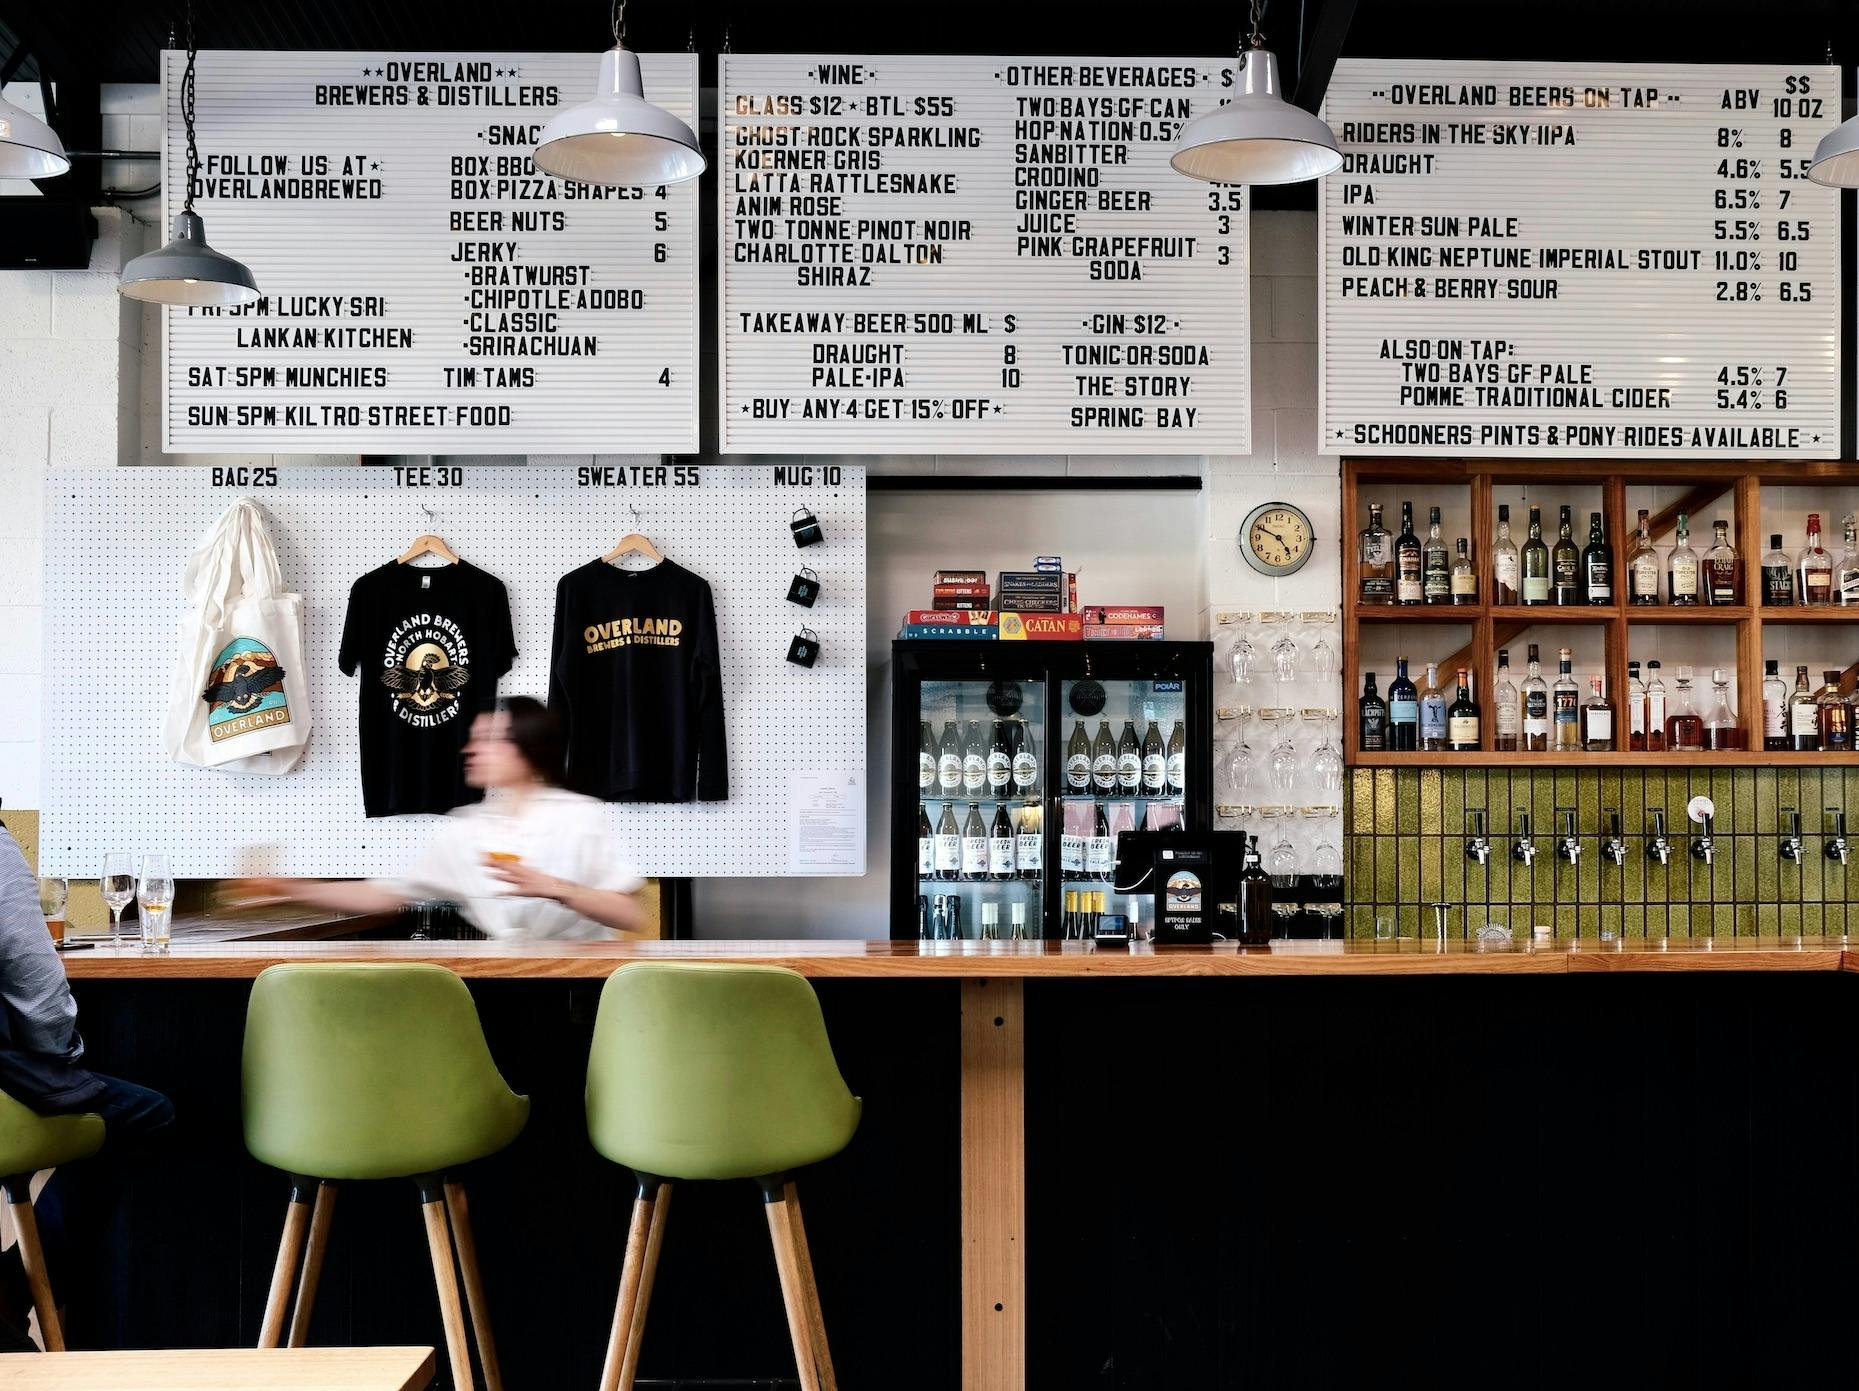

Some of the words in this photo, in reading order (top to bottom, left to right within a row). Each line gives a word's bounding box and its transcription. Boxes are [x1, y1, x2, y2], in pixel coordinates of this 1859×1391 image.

[387, 62, 491, 82] OVERLAND
[819, 65, 863, 84] WINE
[1008, 66, 1072, 86] OTHER
[1080, 67, 1195, 87] BEVERAGES
[316, 85, 407, 105] BREWERS
[417, 86, 429, 105] &
[438, 86, 557, 106] DISTILLERS
[736, 95, 802, 116] GLASS
[810, 96, 841, 115] $12
[867, 96, 904, 116] BTL
[915, 97, 952, 116] $55
[1392, 85, 1496, 105] OVERLAND
[1510, 87, 1573, 106] BEERS
[1584, 88, 1609, 108] ON
[1621, 88, 1657, 107] TAP
[1722, 89, 1759, 109] ABV
[1774, 99, 1791, 117] 10
[1799, 99, 1822, 118] OZ
[737, 127, 800, 146] GHOST
[808, 127, 860, 146] ROCK
[869, 127, 980, 147] SPARKLING
[1344, 123, 1414, 143] RIDERS
[1422, 124, 1440, 144] IN
[1448, 124, 1485, 144] THE
[1493, 125, 1529, 144] SKY
[1538, 126, 1575, 145] IIPA
[1718, 128, 1742, 147] 8%
[1780, 129, 1791, 148] 8
[1016, 144, 1126, 164] SANBITTER
[208, 155, 287, 175] FOLLOW
[302, 156, 327, 175] US
[343, 156, 366, 175] AT
[736, 173, 800, 192] LATTA
[811, 174, 955, 193] RATTLESNAKE
[1015, 167, 1098, 187] CRODINO
[193, 179, 382, 199] OVERLANDBREWED
[451, 212, 502, 231] BEER
[512, 212, 564, 231] NUTS
[655, 212, 666, 231] 5
[735, 220, 773, 239] TWO
[785, 220, 850, 239] TONNE
[858, 220, 915, 240] PINOT
[925, 221, 970, 240] NOIR
[1343, 216, 1413, 236] WINTER
[1421, 217, 1458, 236] SUN
[1469, 217, 1517, 237] PALE
[1715, 221, 1759, 240] 5.5%
[1778, 221, 1809, 240] 6.5
[735, 243, 853, 263] CHARLOTTE
[863, 244, 941, 263] DALTON
[1343, 247, 1379, 265] OLD
[1388, 247, 1431, 266] KING
[1440, 248, 1531, 267] NEPTUNE
[1540, 249, 1629, 269] IMPERIAL
[1639, 250, 1700, 269] STOUT
[1716, 251, 1760, 270] 11.0%
[1780, 252, 1796, 271] 10
[472, 266, 589, 285] BRATWURST
[798, 267, 870, 286] SHIRAZ
[472, 290, 569, 309] CHIPOTLE
[577, 290, 642, 309] ADOBO
[1343, 278, 1407, 297] PEACH
[1415, 278, 1425, 297] &
[1435, 279, 1497, 298] BERRY
[1508, 279, 1557, 298] SOUR
[1717, 282, 1761, 301] 2.8%
[1780, 282, 1810, 301] 6.5
[471, 313, 556, 332] CLASSIC
[740, 313, 844, 332] TAKEAWAY
[854, 314, 905, 333] BEER
[915, 314, 952, 333] 500
[964, 314, 987, 333] ML
[1093, 315, 1124, 334] GIN
[1134, 315, 1165, 334] $12
[238, 328, 316, 347] LANKAN
[325, 328, 411, 348] KITCHEN
[470, 336, 596, 355] SRIRACHUAN
[1062, 346, 1120, 365] TONIC
[1127, 346, 1152, 365] OR
[1159, 346, 1208, 365] SODA
[189, 367, 226, 386] SAT
[237, 368, 275, 386] 5PM
[287, 368, 386, 387] MUNCHIES
[1076, 376, 1113, 395] THE
[1126, 377, 1190, 396] STORY
[1401, 386, 1464, 406] POMME
[1476, 387, 1603, 407] TRADITIONAL
[1613, 389, 1669, 408] CIDER
[1718, 390, 1761, 409] 5.4%
[1776, 390, 1786, 409] 6
[1072, 408, 1143, 427] SPRING
[1158, 408, 1196, 427] BAY
[1355, 424, 1471, 444] SCHOONERS
[1482, 426, 1539, 445] PINTS
[1548, 426, 1558, 445] &
[1567, 426, 1615, 445] PONY
[1625, 427, 1682, 446] RIDES
[1692, 428, 1799, 447] AVAILABLE
[213, 467, 248, 486] BAG
[253, 468, 277, 486] 25
[394, 467, 430, 486] TEE
[438, 468, 462, 486] 30
[578, 467, 666, 486] SWEATER
[675, 467, 698, 485] 55
[775, 467, 812, 485] MUG
[823, 467, 840, 485] 10
[1265, 516, 1271, 524] 11
[1275, 513, 1284, 521] 12
[1256, 544, 1264, 552] 8
[1292, 545, 1299, 553] 4
[1274, 555, 1281, 563] 6
[1025, 619, 1066, 633] CATAN
[1108, 612, 1151, 620] CODENAMES
[584, 617, 683, 644] OVERLAND
[383, 613, 431, 669] OVERLAND
[433, 615, 469, 666] BREWERS
[396, 630, 422, 662] NORTH
[425, 629, 458, 663] HOBART
[586, 637, 625, 654] BREWERS
[633, 635, 680, 646] DISTILLERS
[213, 710, 285, 737] OVERLAND
